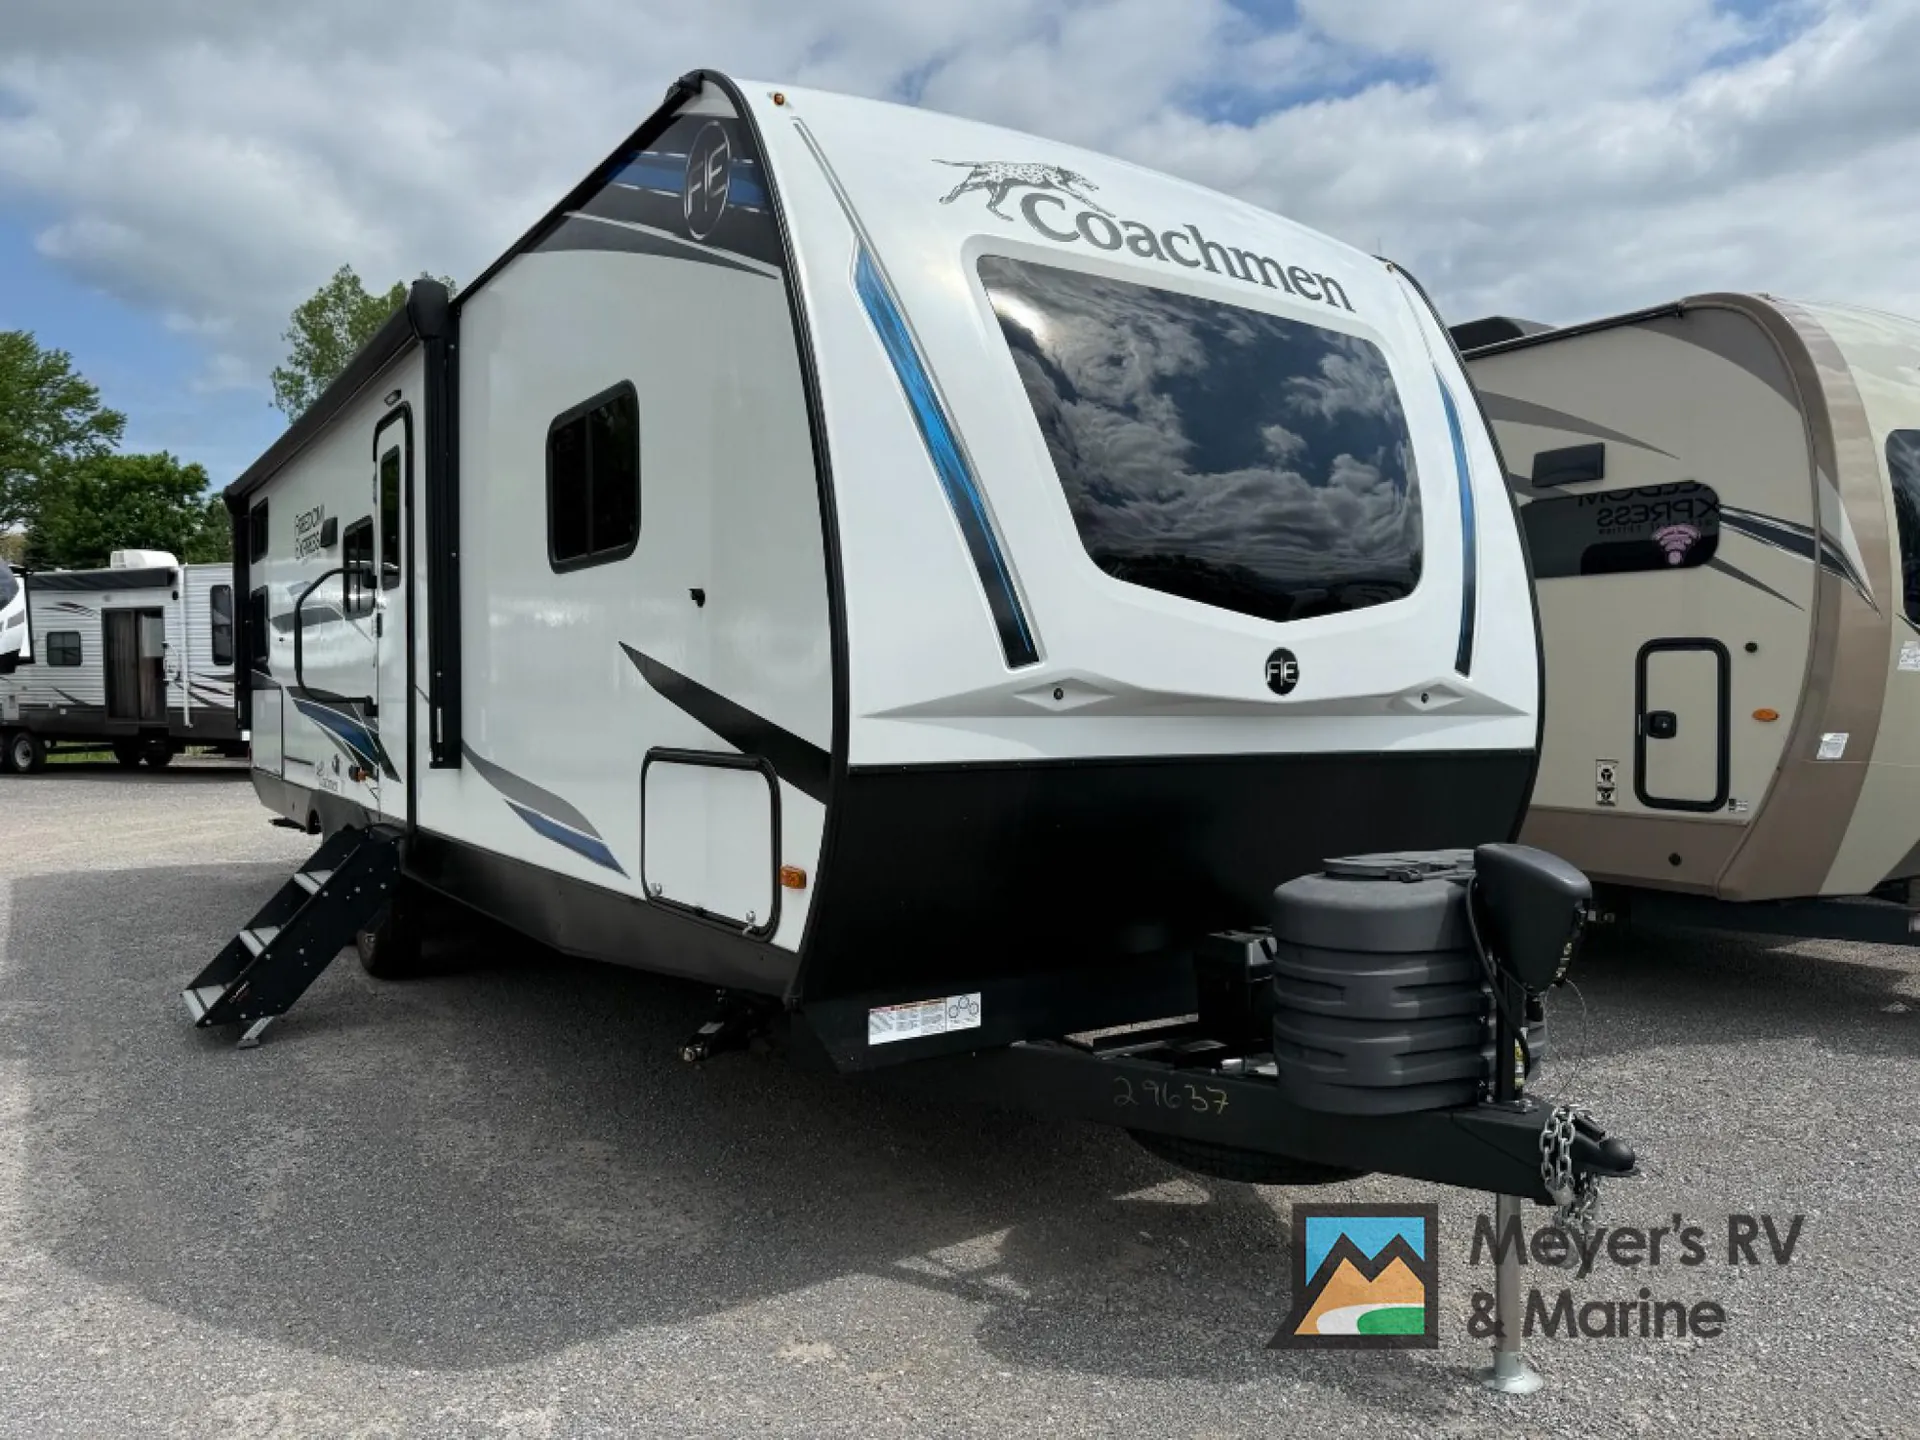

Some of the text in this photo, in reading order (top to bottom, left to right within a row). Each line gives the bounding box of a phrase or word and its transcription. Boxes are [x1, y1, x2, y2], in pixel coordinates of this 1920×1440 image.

[1020, 192, 1356, 314] Coachmen
[295, 503, 325, 535] FREEDOM
[295, 530, 320, 559] EXPRESS
[1113, 1076, 1229, 1114] 29637
